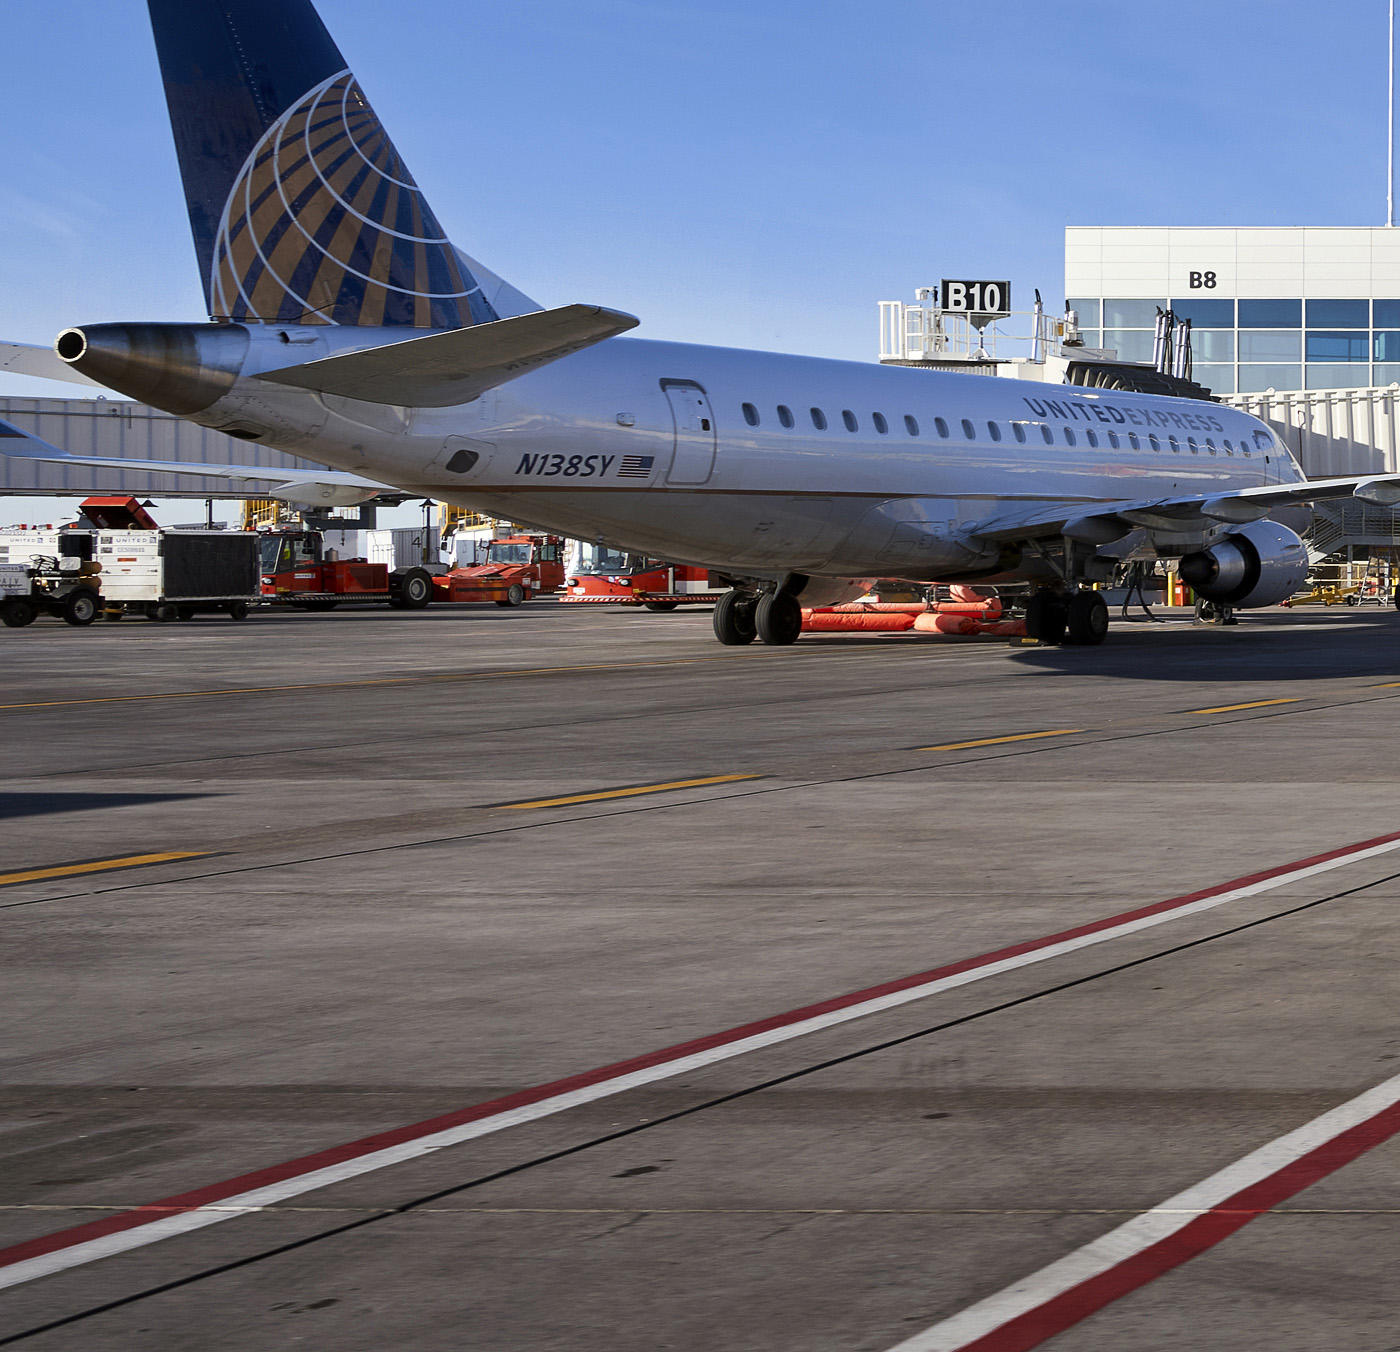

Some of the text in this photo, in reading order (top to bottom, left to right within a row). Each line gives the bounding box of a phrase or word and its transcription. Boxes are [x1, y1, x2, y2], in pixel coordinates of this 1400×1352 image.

[1189, 271, 1217, 289] B8
[948, 282, 1001, 312] B10
[514, 452, 616, 477] N138SY
[411, 536, 422, 548] 4
